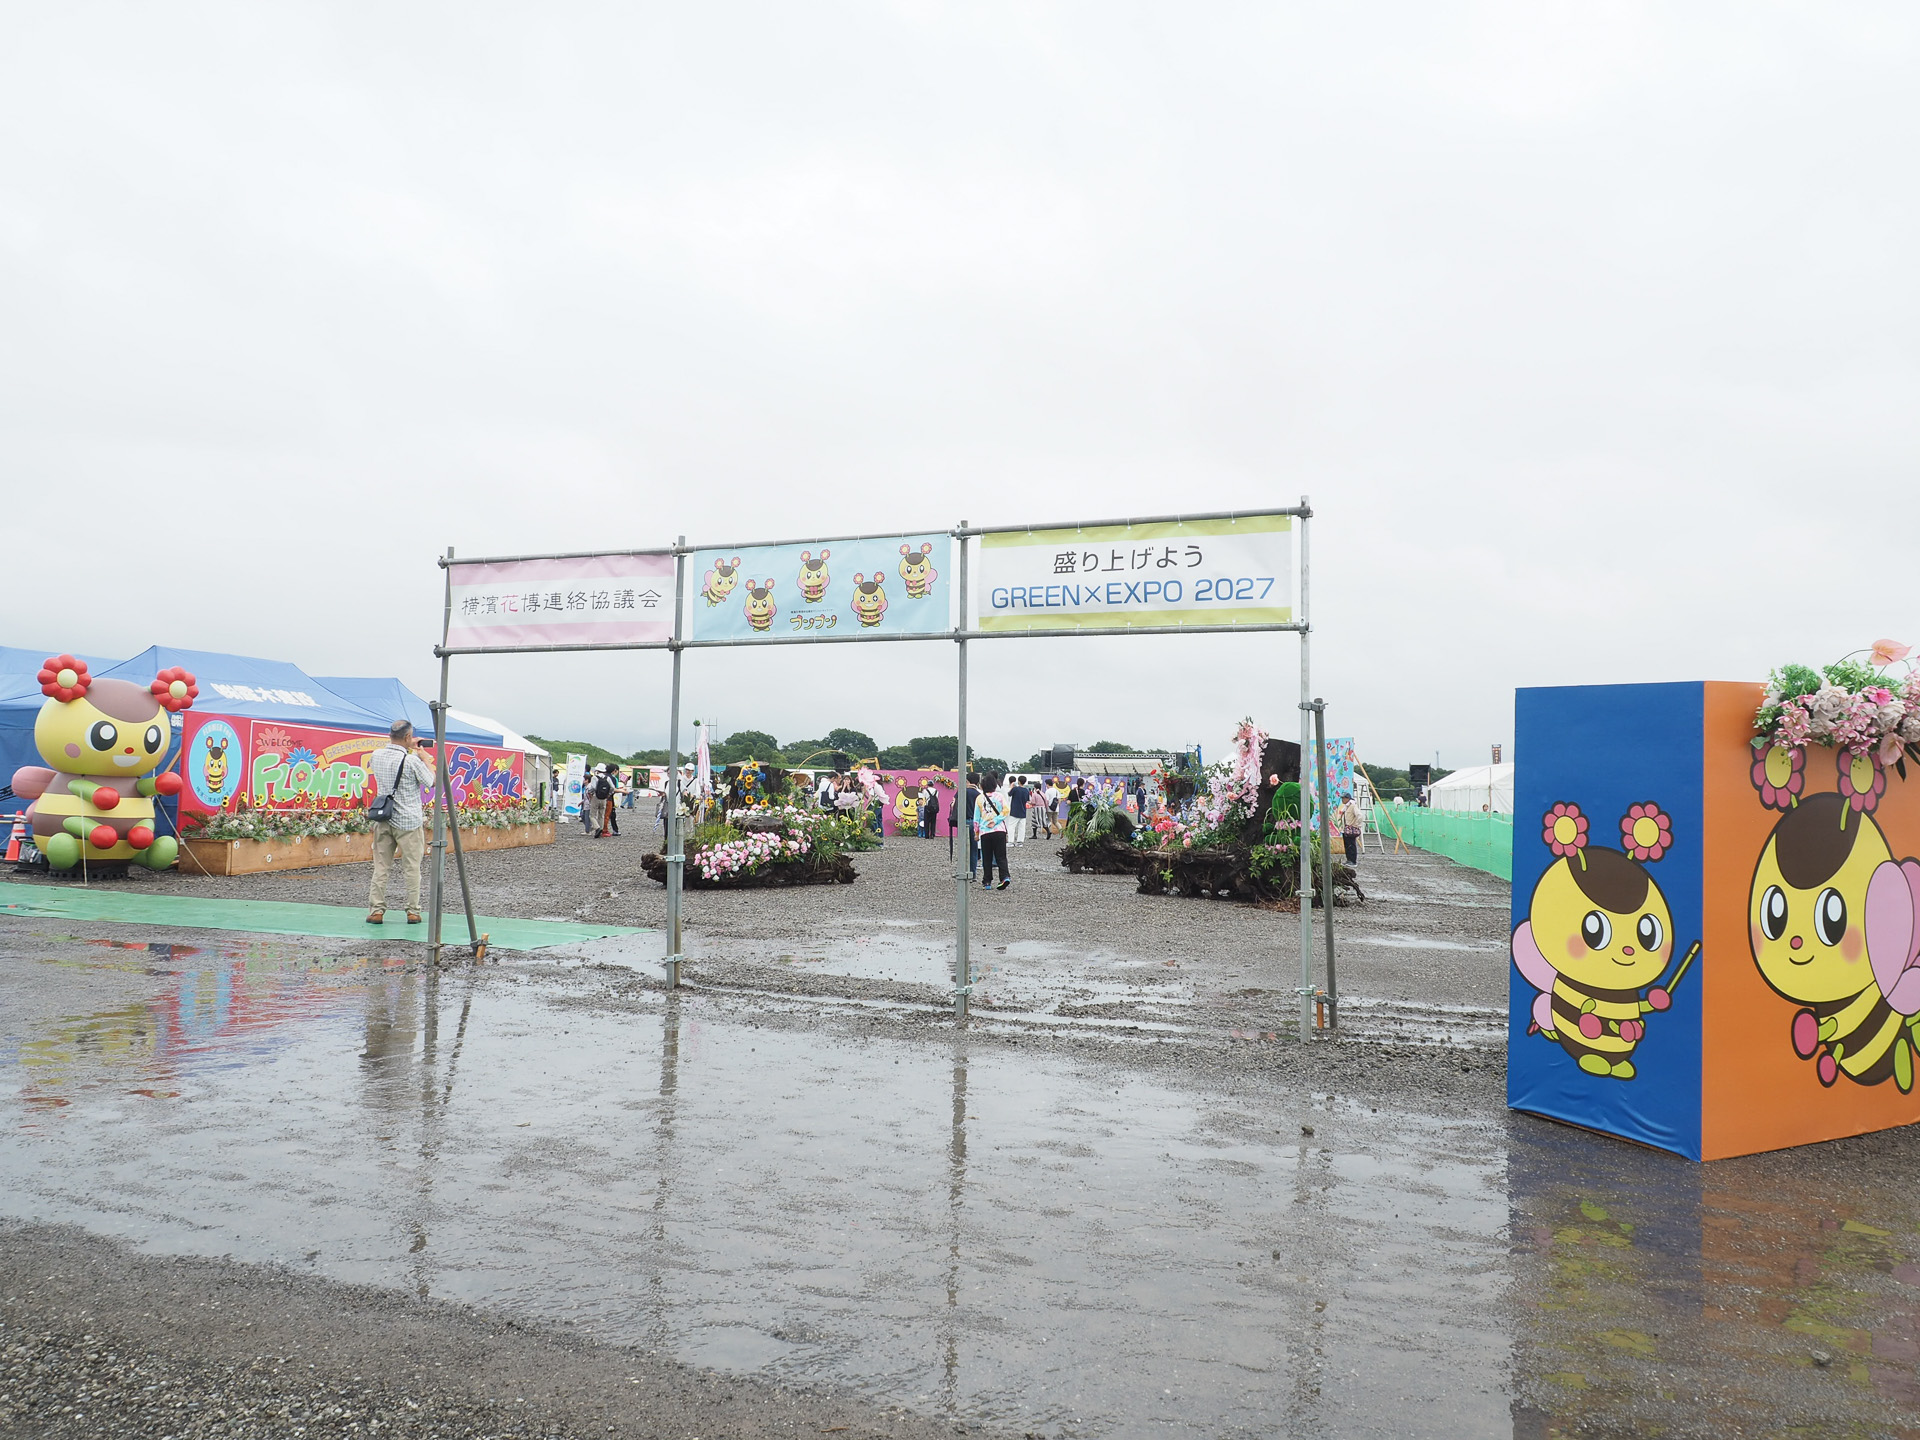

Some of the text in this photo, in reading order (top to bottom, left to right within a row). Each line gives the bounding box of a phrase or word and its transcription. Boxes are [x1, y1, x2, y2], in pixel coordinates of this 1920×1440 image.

[1053, 544, 1205, 575] 盛り上げよう
[461, 588, 662, 616] 横濱花博連絡協議会
[1194, 577, 1276, 602] 2027
[261, 738, 303, 748] WELCOME
[252, 753, 366, 806] FLOWER
